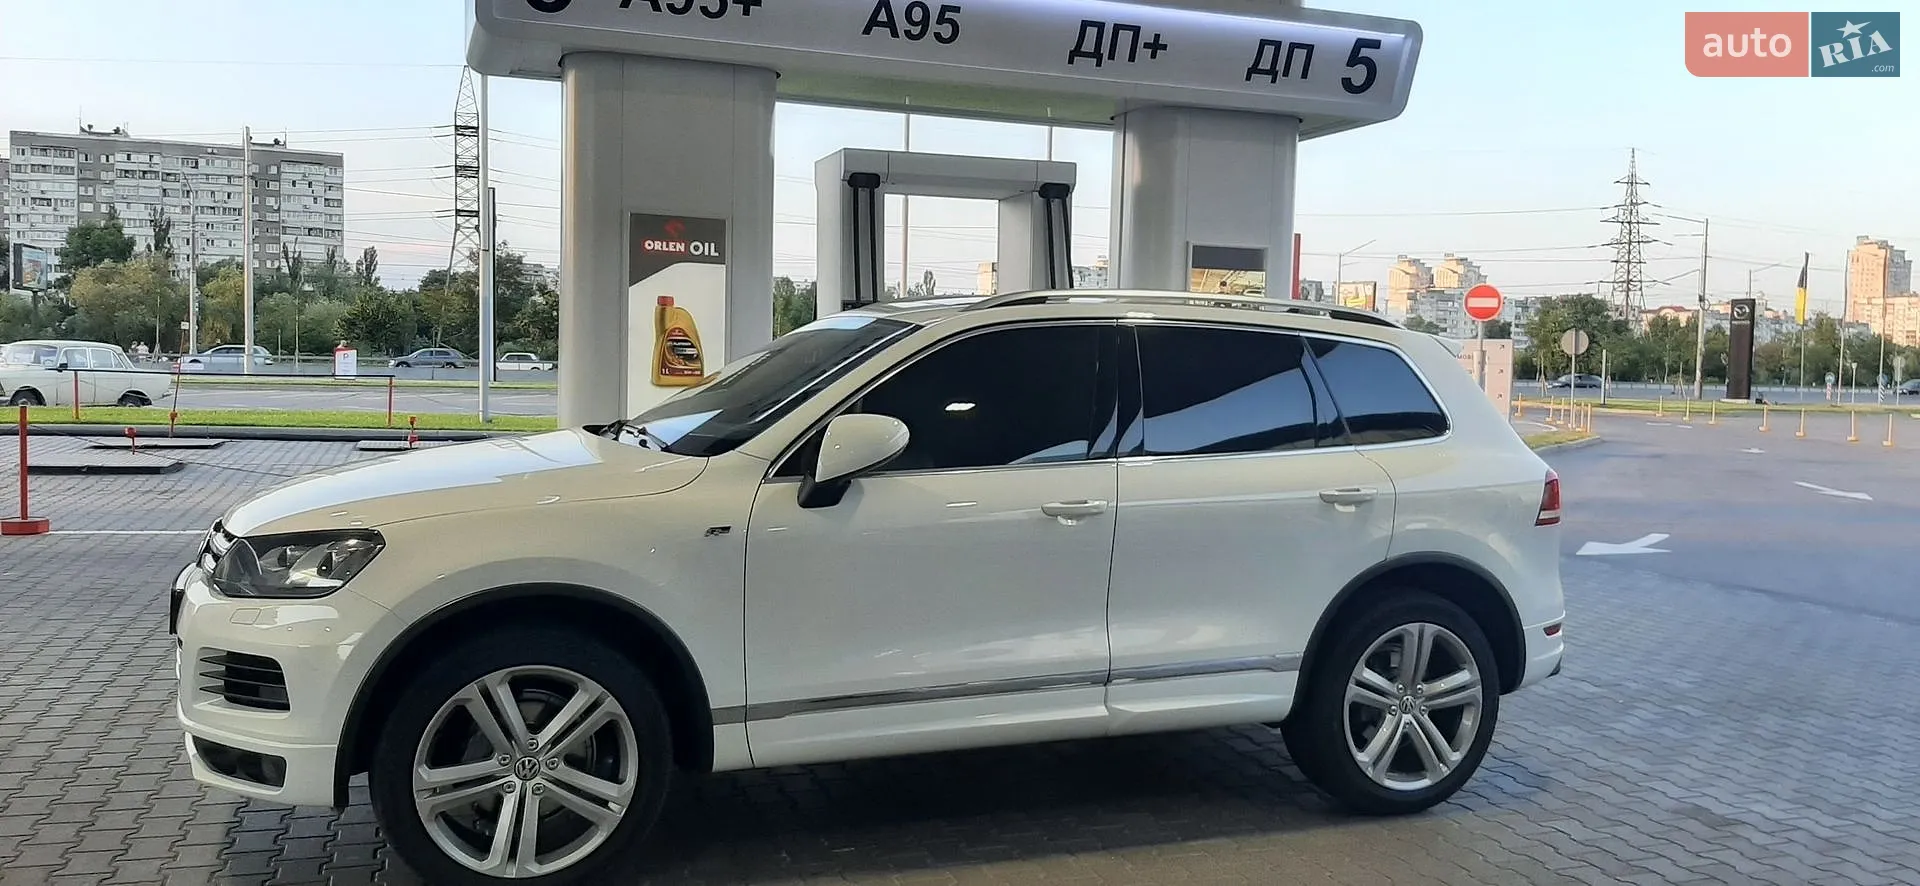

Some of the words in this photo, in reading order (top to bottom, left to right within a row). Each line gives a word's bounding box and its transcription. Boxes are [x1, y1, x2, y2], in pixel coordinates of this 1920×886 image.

[1067, 20, 1168, 67] ДП+
[1245, 38, 1315, 84] ДП
[1341, 37, 1382, 95] 5
[644, 239, 685, 252] ORLEN
[689, 241, 719, 256] OIL
